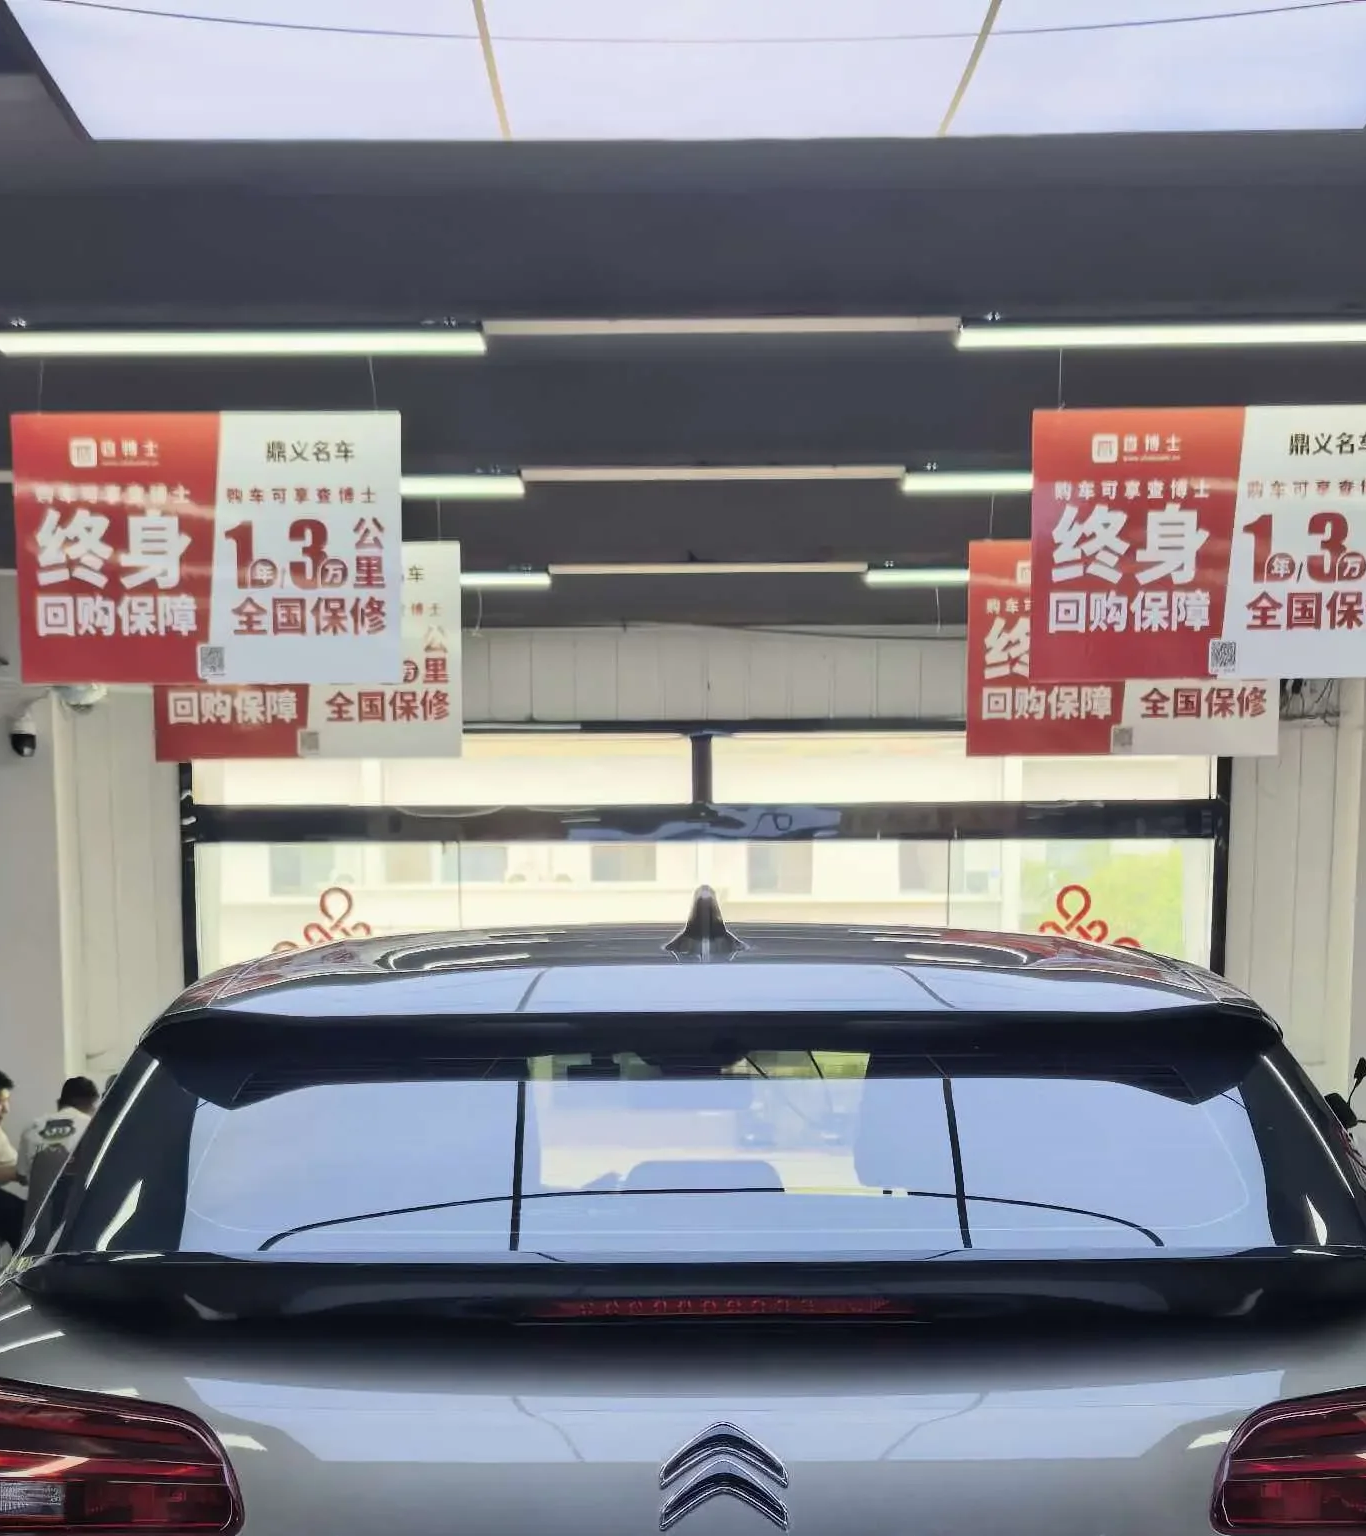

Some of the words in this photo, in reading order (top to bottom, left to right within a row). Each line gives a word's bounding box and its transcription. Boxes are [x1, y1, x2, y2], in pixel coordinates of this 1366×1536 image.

[266, 440, 355, 463] 鼎义名车
[36, 507, 192, 590] 终身
[1051, 503, 1210, 586] 终身
[37, 594, 197, 637] 回购保障
[232, 597, 387, 636] 全国保修
[1048, 589, 1212, 634] 回购保障
[168, 690, 298, 724] 回购保障
[325, 690, 449, 723] 全国保修
[982, 686, 1112, 720] 回购保障
[1140, 687, 1268, 719] 全国保修
